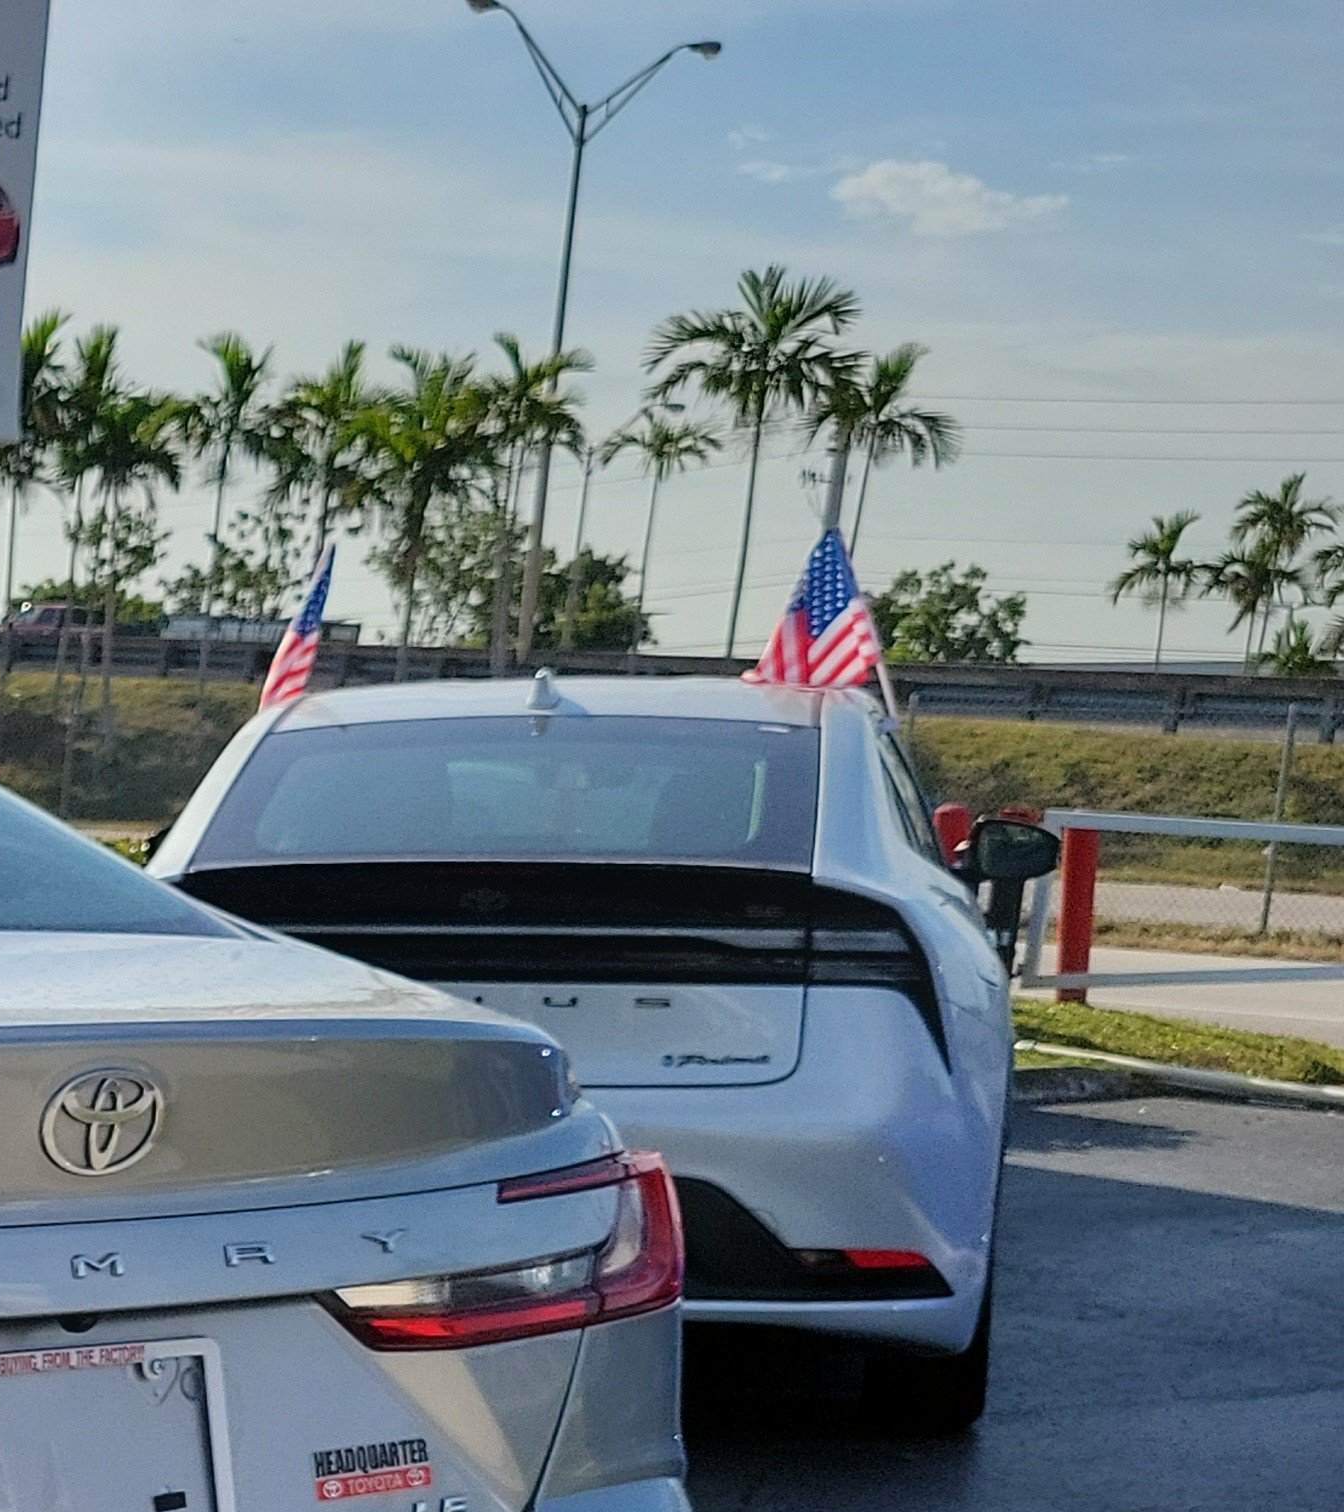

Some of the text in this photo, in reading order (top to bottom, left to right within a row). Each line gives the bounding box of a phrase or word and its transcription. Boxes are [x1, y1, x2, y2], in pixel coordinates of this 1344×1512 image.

[0, 1354, 39, 1373] BUYING
[43, 1351, 71, 1370] FROM
[75, 1349, 95, 1367] THE
[312, 1438, 429, 1479] HEADQUARTER
[347, 1472, 404, 1494] TOYOTA
